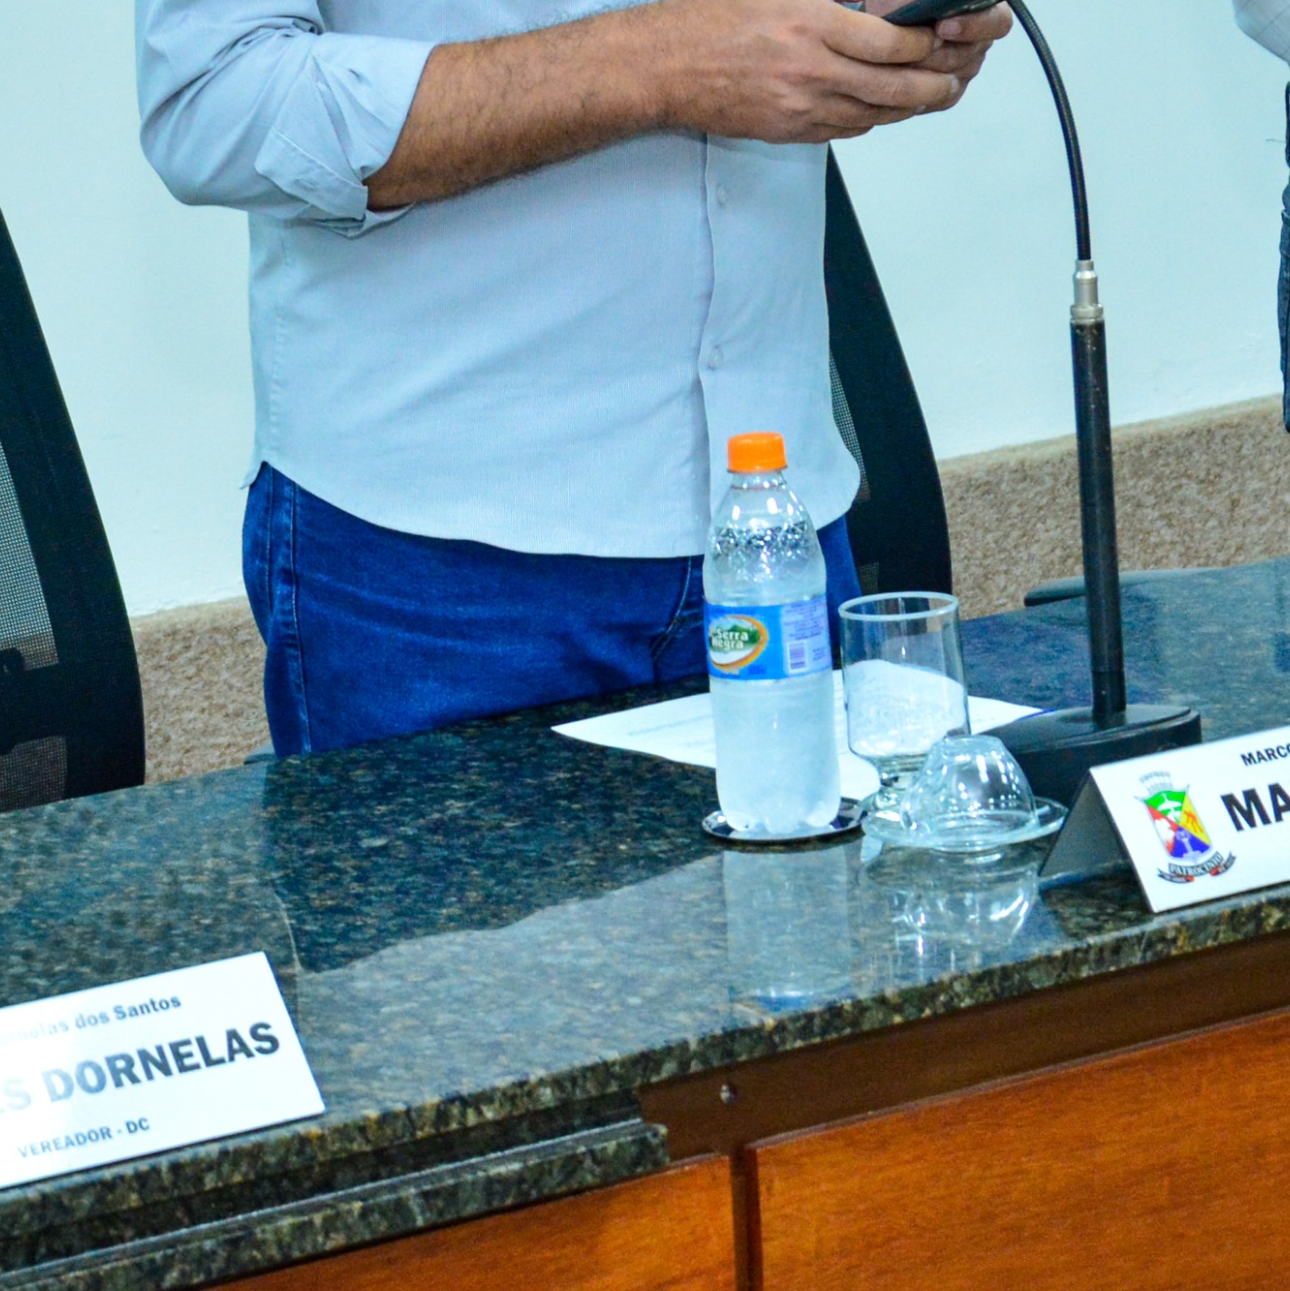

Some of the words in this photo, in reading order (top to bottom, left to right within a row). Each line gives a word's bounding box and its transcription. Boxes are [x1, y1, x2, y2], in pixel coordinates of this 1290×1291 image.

[716, 628, 749, 642] Serra
[75, 1011, 110, 1030] dos
[112, 995, 182, 1021] Santos
[41, 1021, 281, 1103] DORNELAS
[16, 1126, 113, 1159] VEREADOR
[125, 1116, 151, 1135] DC
